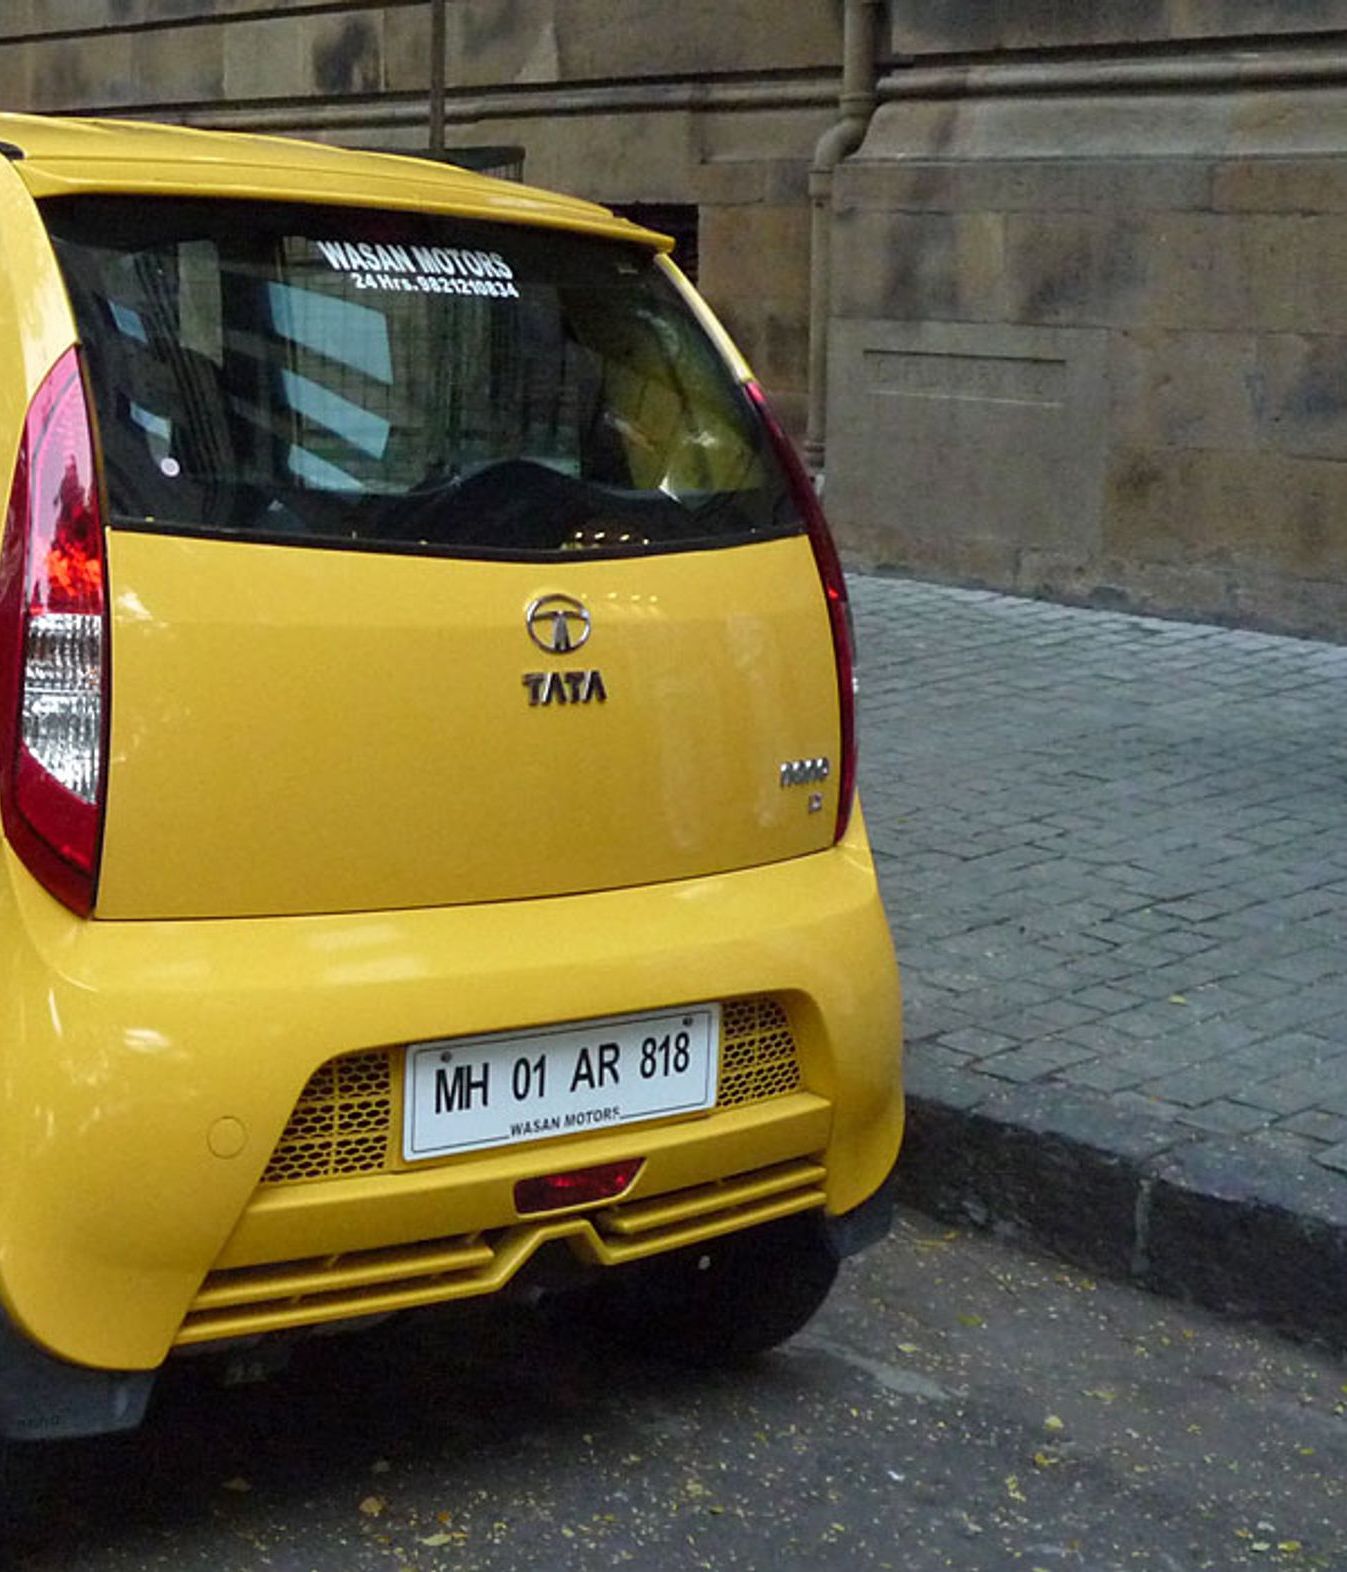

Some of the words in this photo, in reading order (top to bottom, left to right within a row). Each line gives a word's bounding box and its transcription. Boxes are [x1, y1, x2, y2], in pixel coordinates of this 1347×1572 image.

[316, 240, 416, 273] WASAN
[409, 245, 513, 279] MOTORS
[351, 272, 378, 289] 24
[522, 670, 607, 706] TATA
[435, 1062, 489, 1114] MH
[512, 1053, 546, 1101] 01
[570, 1042, 621, 1093] AR
[639, 1031, 690, 1080] 818
[509, 1117, 561, 1137] WASAN
[563, 1106, 621, 1128] MOTORS
